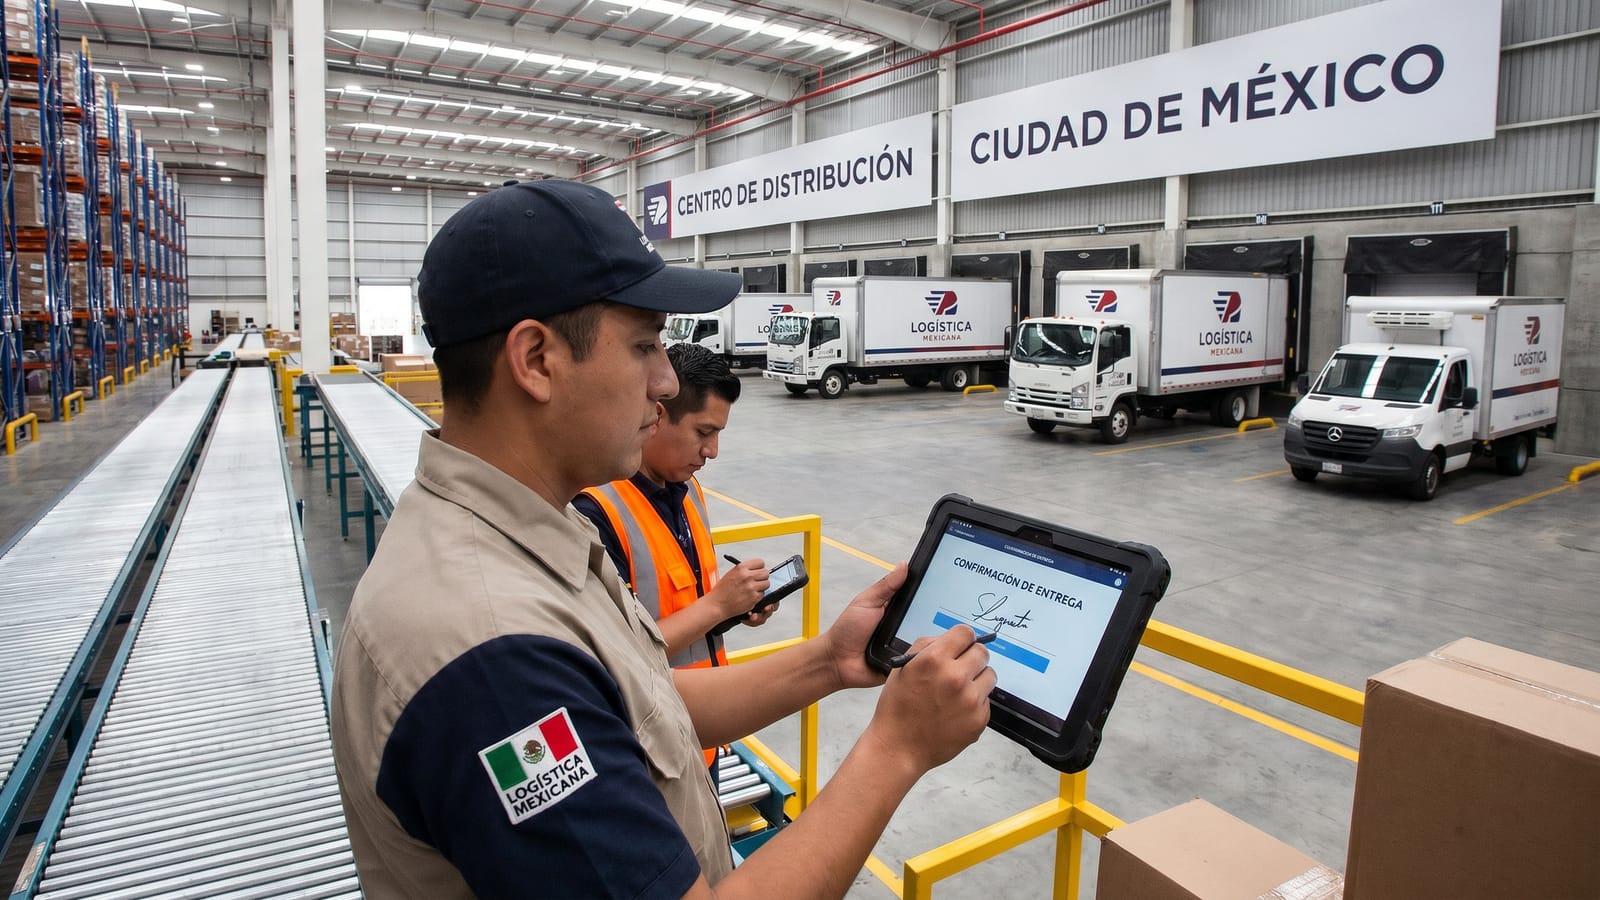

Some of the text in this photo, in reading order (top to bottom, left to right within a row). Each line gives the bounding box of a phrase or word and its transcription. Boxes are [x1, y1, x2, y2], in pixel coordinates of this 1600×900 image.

[970, 43, 1445, 165] CIUDAD DE MÉXICO
[677, 143, 913, 216] CENTRO DE DISTRIBUCIÓN
[911, 318, 972, 333] LOGÍSTICA
[922, 334, 961, 342] MEXICANA
[1199, 327, 1253, 346] LOGÍSTICA
[953, 557, 1083, 611] CONFIRMACIÓN DE ENTREGA
[506, 754, 584, 805] LOGÍSTICA
[513, 766, 590, 817] MEXICANA
